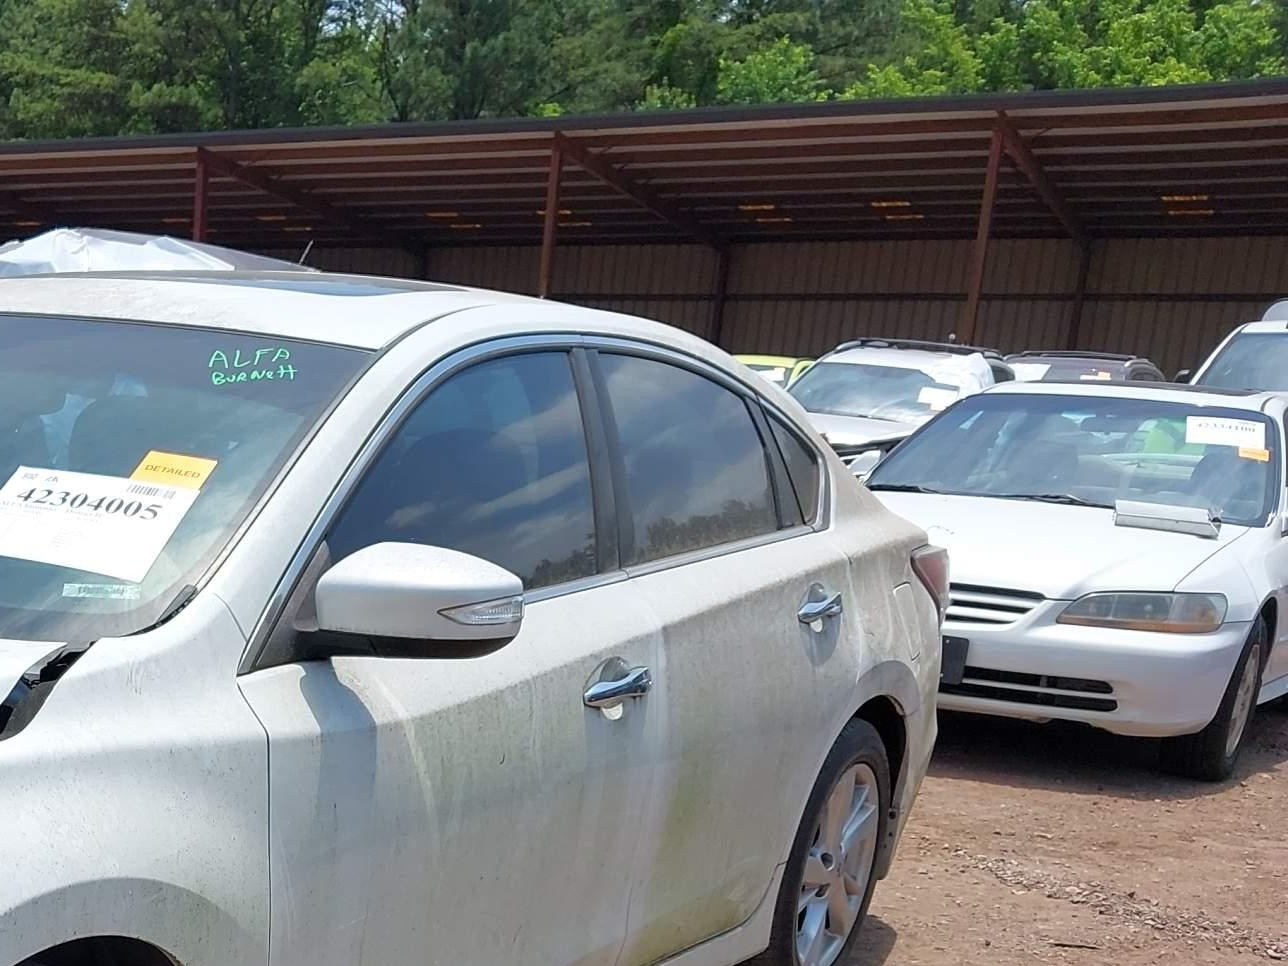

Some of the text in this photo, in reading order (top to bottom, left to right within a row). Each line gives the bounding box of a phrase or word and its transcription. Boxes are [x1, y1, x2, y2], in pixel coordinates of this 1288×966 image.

[208, 347, 291, 369] ALFA
[144, 464, 202, 479] DETAILED
[16, 487, 164, 521] 42304005
